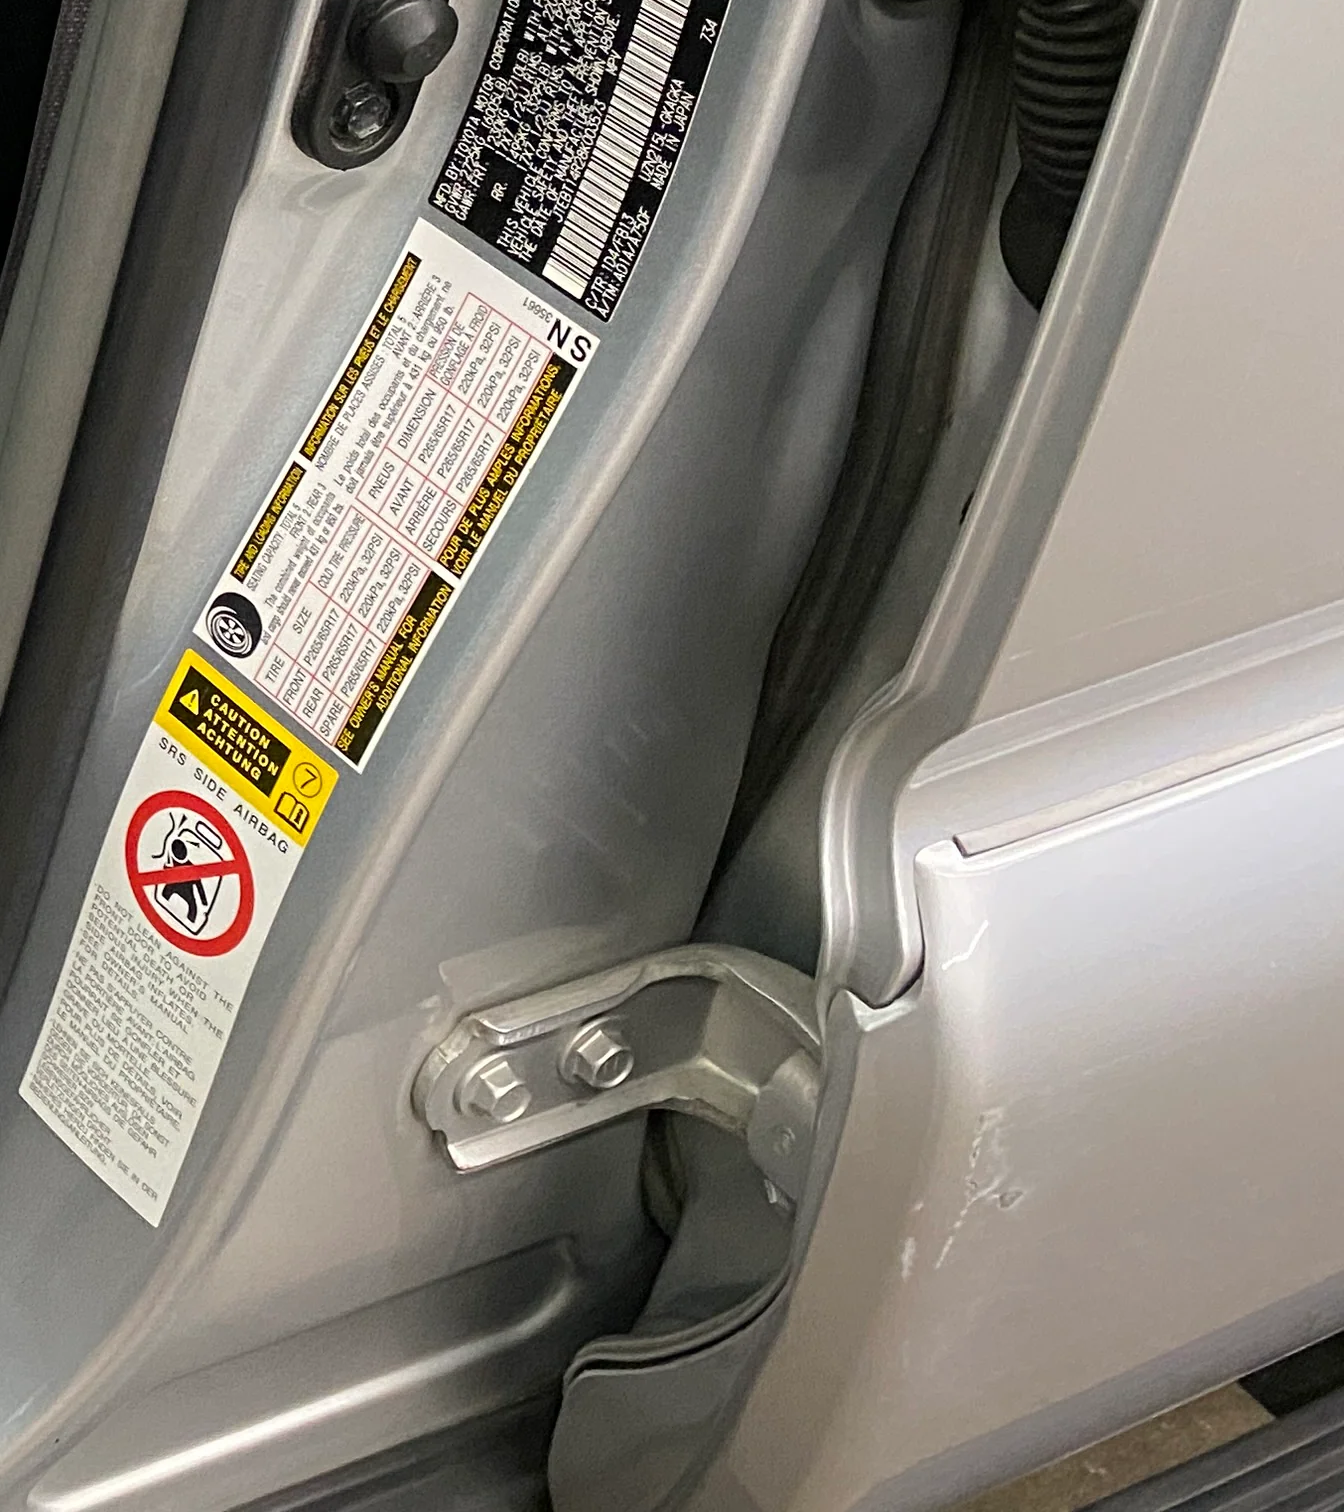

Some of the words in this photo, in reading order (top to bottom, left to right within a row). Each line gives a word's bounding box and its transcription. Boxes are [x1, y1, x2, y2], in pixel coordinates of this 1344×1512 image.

[575, 6, 611, 87] PREVENTION
[597, 12, 621, 57] ABOVE.
[699, 18, 718, 44] 734
[483, 107, 511, 153] 1230KG
[523, 9, 544, 42] WITH
[564, 55, 584, 79] ALL
[584, 56, 610, 101] SHOWN
[604, 49, 622, 77] MPV
[473, 73, 497, 113] MOTOR
[490, 182, 508, 202] RR.
[505, 121, 532, 167] 1495KG
[545, 19, 566, 56] WITH
[494, 127, 516, 160] 17X7
[536, 23, 552, 43] AT
[516, 140, 538, 172] 17X7
[558, 36, 572, 57] AT
[557, 79, 575, 100] TO
[561, 85, 584, 126] THEFT
[670, 90, 695, 133] JAPAN
[535, 99, 569, 160] CONFORMS
[551, 128, 573, 156] AND
[552, 98, 595, 185] MANUFACTURE
[662, 133, 681, 152] IN
[511, 161, 545, 217] VEHICLE
[531, 155, 561, 206] SAFETY
[545, 182, 564, 206] OF
[649, 155, 673, 191] MADE
[496, 217, 519, 252] THIS
[506, 202, 541, 258] VEHICLE
[530, 203, 553, 238] DATE
[517, 236, 538, 263] THE
[303, 402, 340, 457] INFORMATION
[333, 383, 350, 404] SUR
[344, 366, 360, 385] LES
[353, 338, 376, 369] PNEUS
[368, 324, 381, 340] ET
[376, 311, 390, 327] LE
[383, 256, 417, 314] CHARGEMENT
[426, 332, 458, 380] PRESSION
[449, 319, 466, 337] DE
[439, 340, 470, 387] GONFLAGE
[468, 304, 492, 334] FROID
[479, 321, 502, 354] 32PSI
[498, 335, 522, 368] 32PSI
[518, 348, 541, 382] 32PSI
[314, 434, 340, 472] NOMBRE
[334, 421, 349, 437] DE
[342, 389, 366, 423] PLACES
[361, 354, 386, 391] ASSISES
[381, 324, 403, 351] TOTAL
[396, 387, 437, 450] DIMENSION
[417, 403, 456, 465] P265/65R17
[436, 417, 476, 480] P265/65R17
[368, 461, 395, 500] PNEUS
[455, 432, 495, 494] P265/65R17
[502, 466, 519, 486] DU
[270, 466, 304, 515] INFORMATION
[389, 476, 414, 517] AVANT
[404, 486, 438, 537] ARRIÈRE
[439, 535, 463, 568] POUR
[457, 516, 474, 535] DE
[468, 486, 491, 517] PLUS
[486, 440, 516, 488] AMPLES
[476, 488, 509, 535] MANUEL
[360, 532, 384, 565] 32PSI
[422, 499, 457, 552] SECOURS
[467, 530, 486, 552] LE
[317, 567, 335, 589] COLD
[328, 550, 345, 569] TIRE
[338, 510, 368, 553] PRESSURE
[379, 547, 402, 580] 32PSI
[450, 547, 476, 580] VOIR
[398, 562, 421, 595] 32PSI
[292, 606, 313, 635] SIZE
[303, 607, 340, 667] P265/65R17
[264, 655, 286, 683] TIRE
[321, 622, 358, 683] P265/65R17
[339, 638, 378, 698] P265/65R17
[375, 655, 416, 717] ADDITIONAL
[407, 583, 455, 657] INFORMATION
[282, 667, 307, 706] FRONT
[302, 687, 325, 719] REAR
[333, 724, 355, 752] SEE
[349, 681, 380, 729] OWNER'S
[373, 641, 404, 682] MANUAL
[398, 614, 418, 639] FOR
[210, 694, 271, 750] CAUTION
[319, 699, 345, 737] SPARE
[196, 722, 262, 781] ACHTUNG
[202, 708, 279, 776] ATTENTION
[158, 737, 187, 766] SRS
[193, 767, 227, 802] SIDE
[233, 804, 289, 854] AIRBAG
[300, 767, 318, 798] 7
[136, 922, 162, 951] LEAN
[164, 951, 210, 990] AGAINST
[214, 990, 234, 1013] THE
